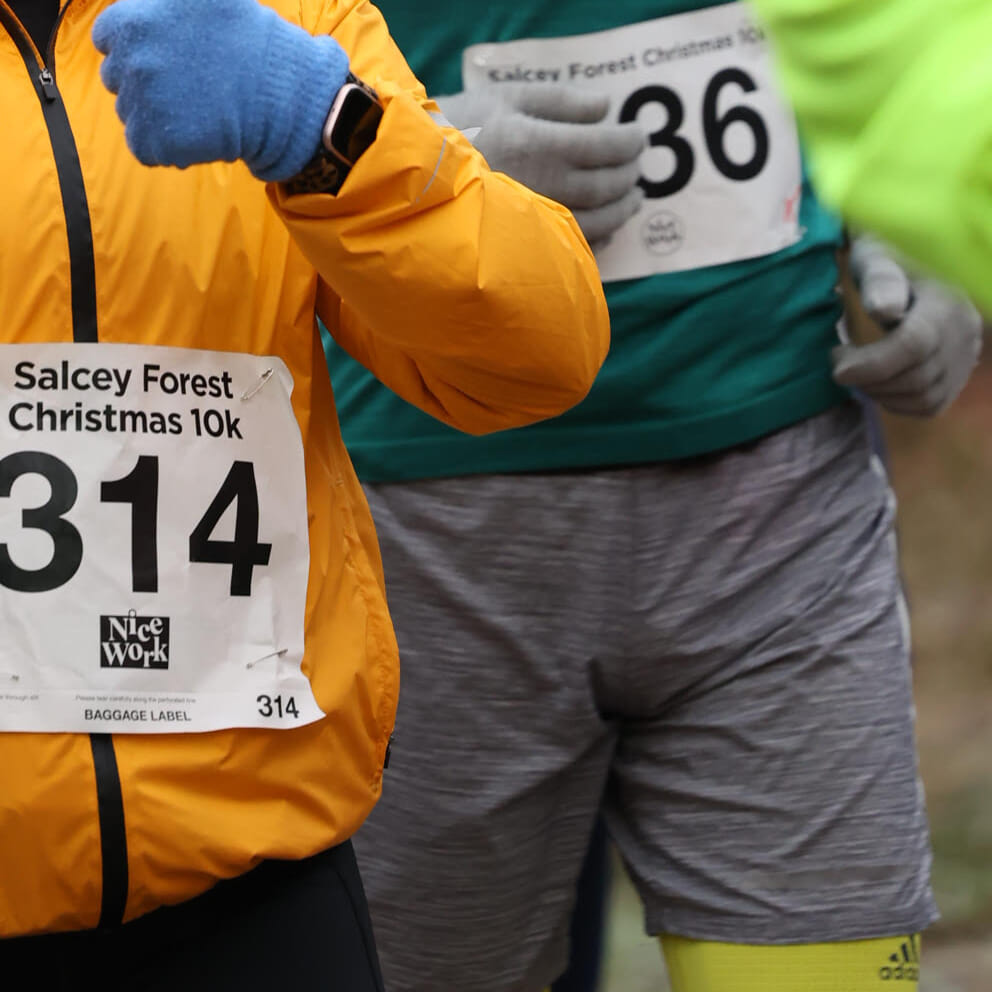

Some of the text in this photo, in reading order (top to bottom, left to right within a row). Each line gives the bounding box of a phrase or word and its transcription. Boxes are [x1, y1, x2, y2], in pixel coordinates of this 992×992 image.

[568, 56, 636, 79] Forest
[642, 34, 733, 68] Christmas
[13, 361, 234, 399] Salcey Forest
[8, 402, 244, 440] Christmas 10k
[108, 608, 163, 642] Nice
[101, 636, 169, 668] Work
[84, 708, 192, 722] BAGGAGE LABEL
[257, 694, 300, 719] 314
